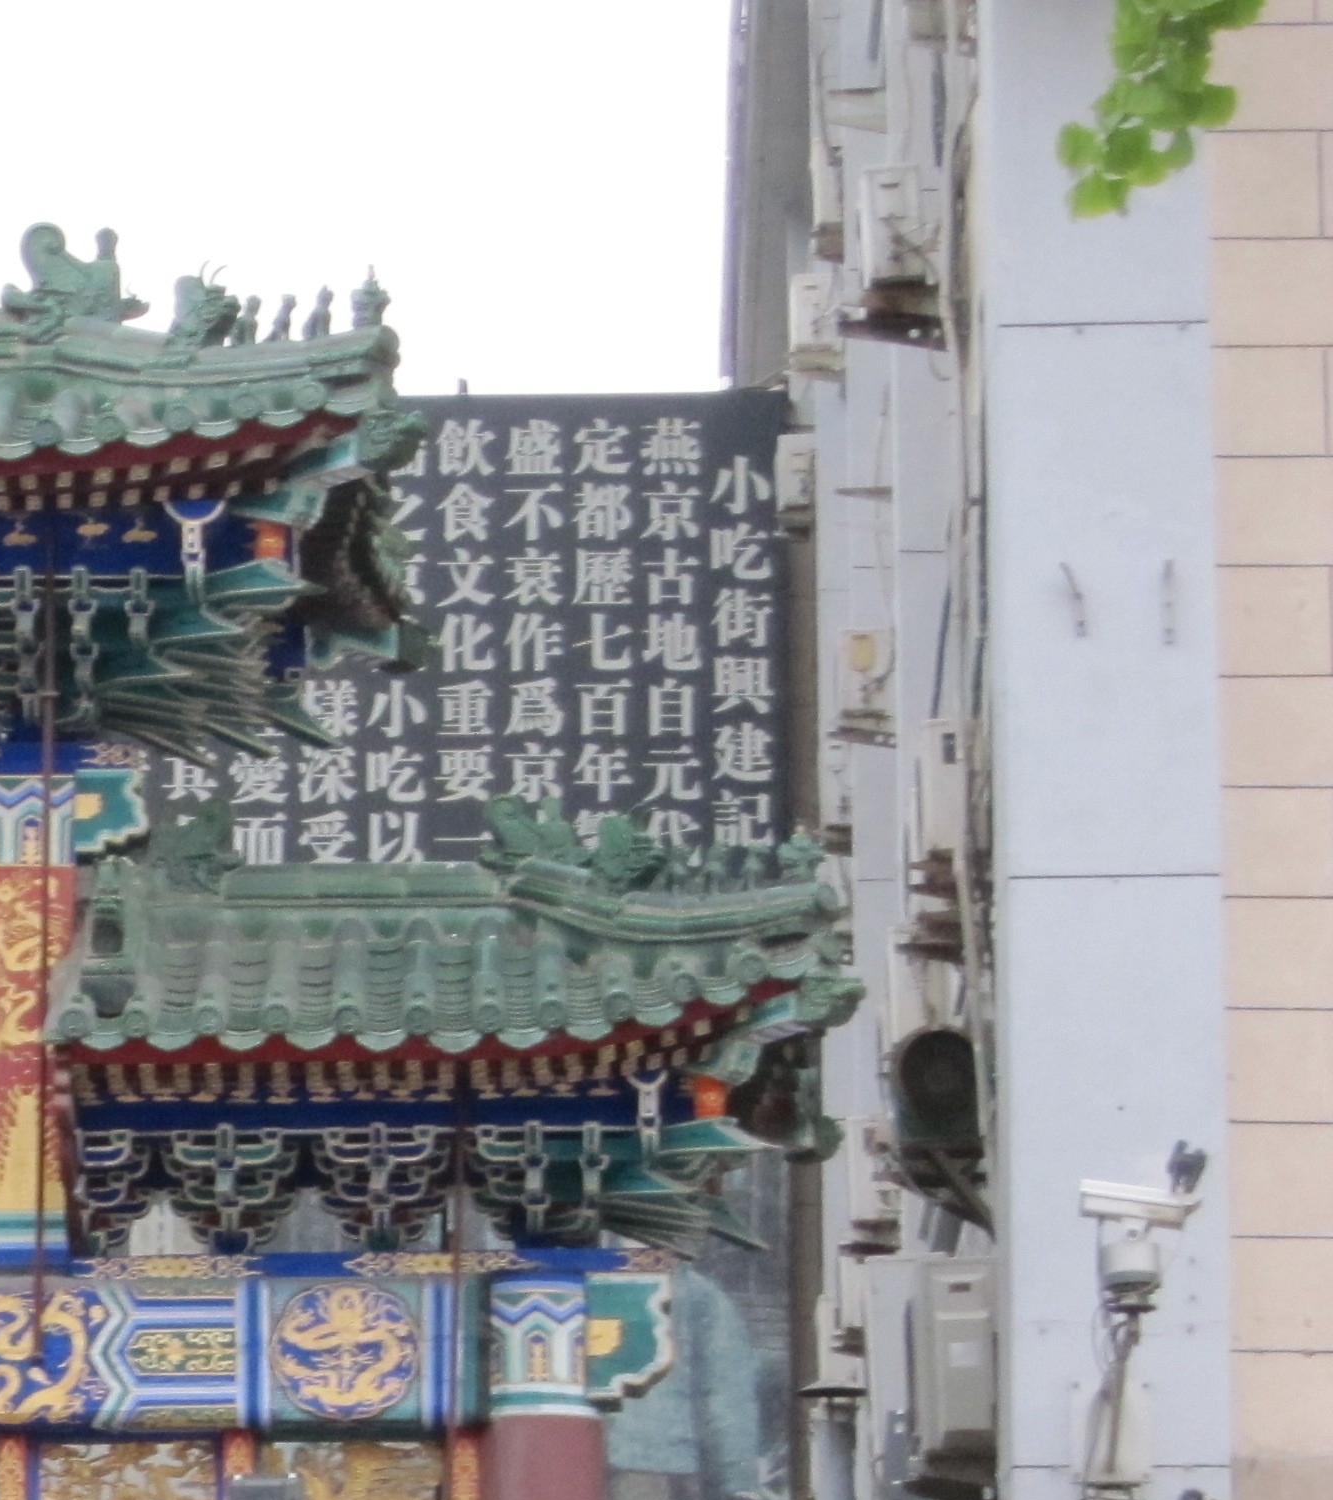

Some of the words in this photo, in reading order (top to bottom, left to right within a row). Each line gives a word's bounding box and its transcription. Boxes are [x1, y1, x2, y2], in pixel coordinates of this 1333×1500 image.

[433, 418, 496, 842] 飲食文化重要一
[710, 455, 774, 848] 小吃街興建記
